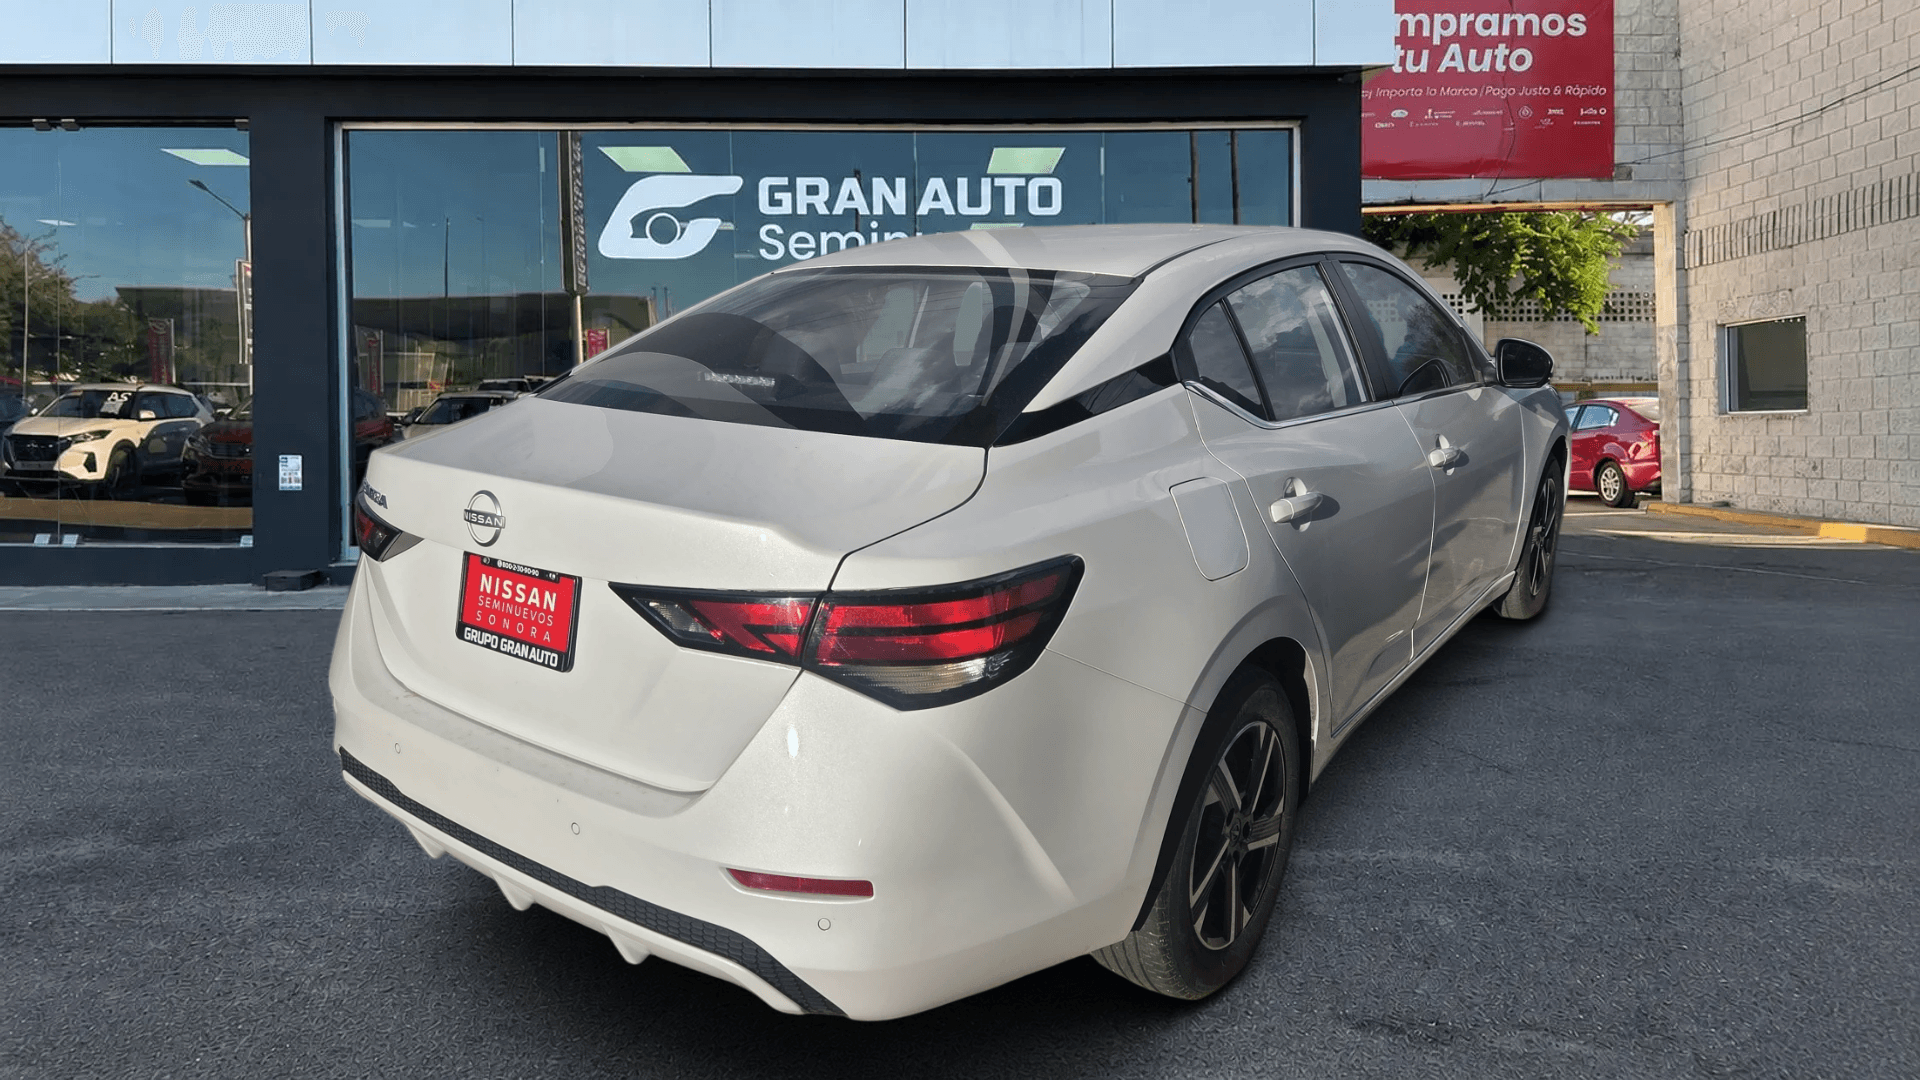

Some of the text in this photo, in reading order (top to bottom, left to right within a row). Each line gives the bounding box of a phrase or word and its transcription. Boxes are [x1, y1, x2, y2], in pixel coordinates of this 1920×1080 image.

[1394, 13, 1587, 45] mpramos
[1392, 43, 1533, 73] tu Auto
[1440, 86, 1478, 96] Marca
[1485, 86, 1516, 99] Pago
[1519, 86, 1551, 96] Justo
[758, 176, 1063, 216] GRAN AUTO
[464, 510, 505, 528] NISSAN
[480, 573, 557, 612] NISSAN
[478, 595, 554, 627] SEMINUEVOS
[464, 627, 499, 649] GRUPO
